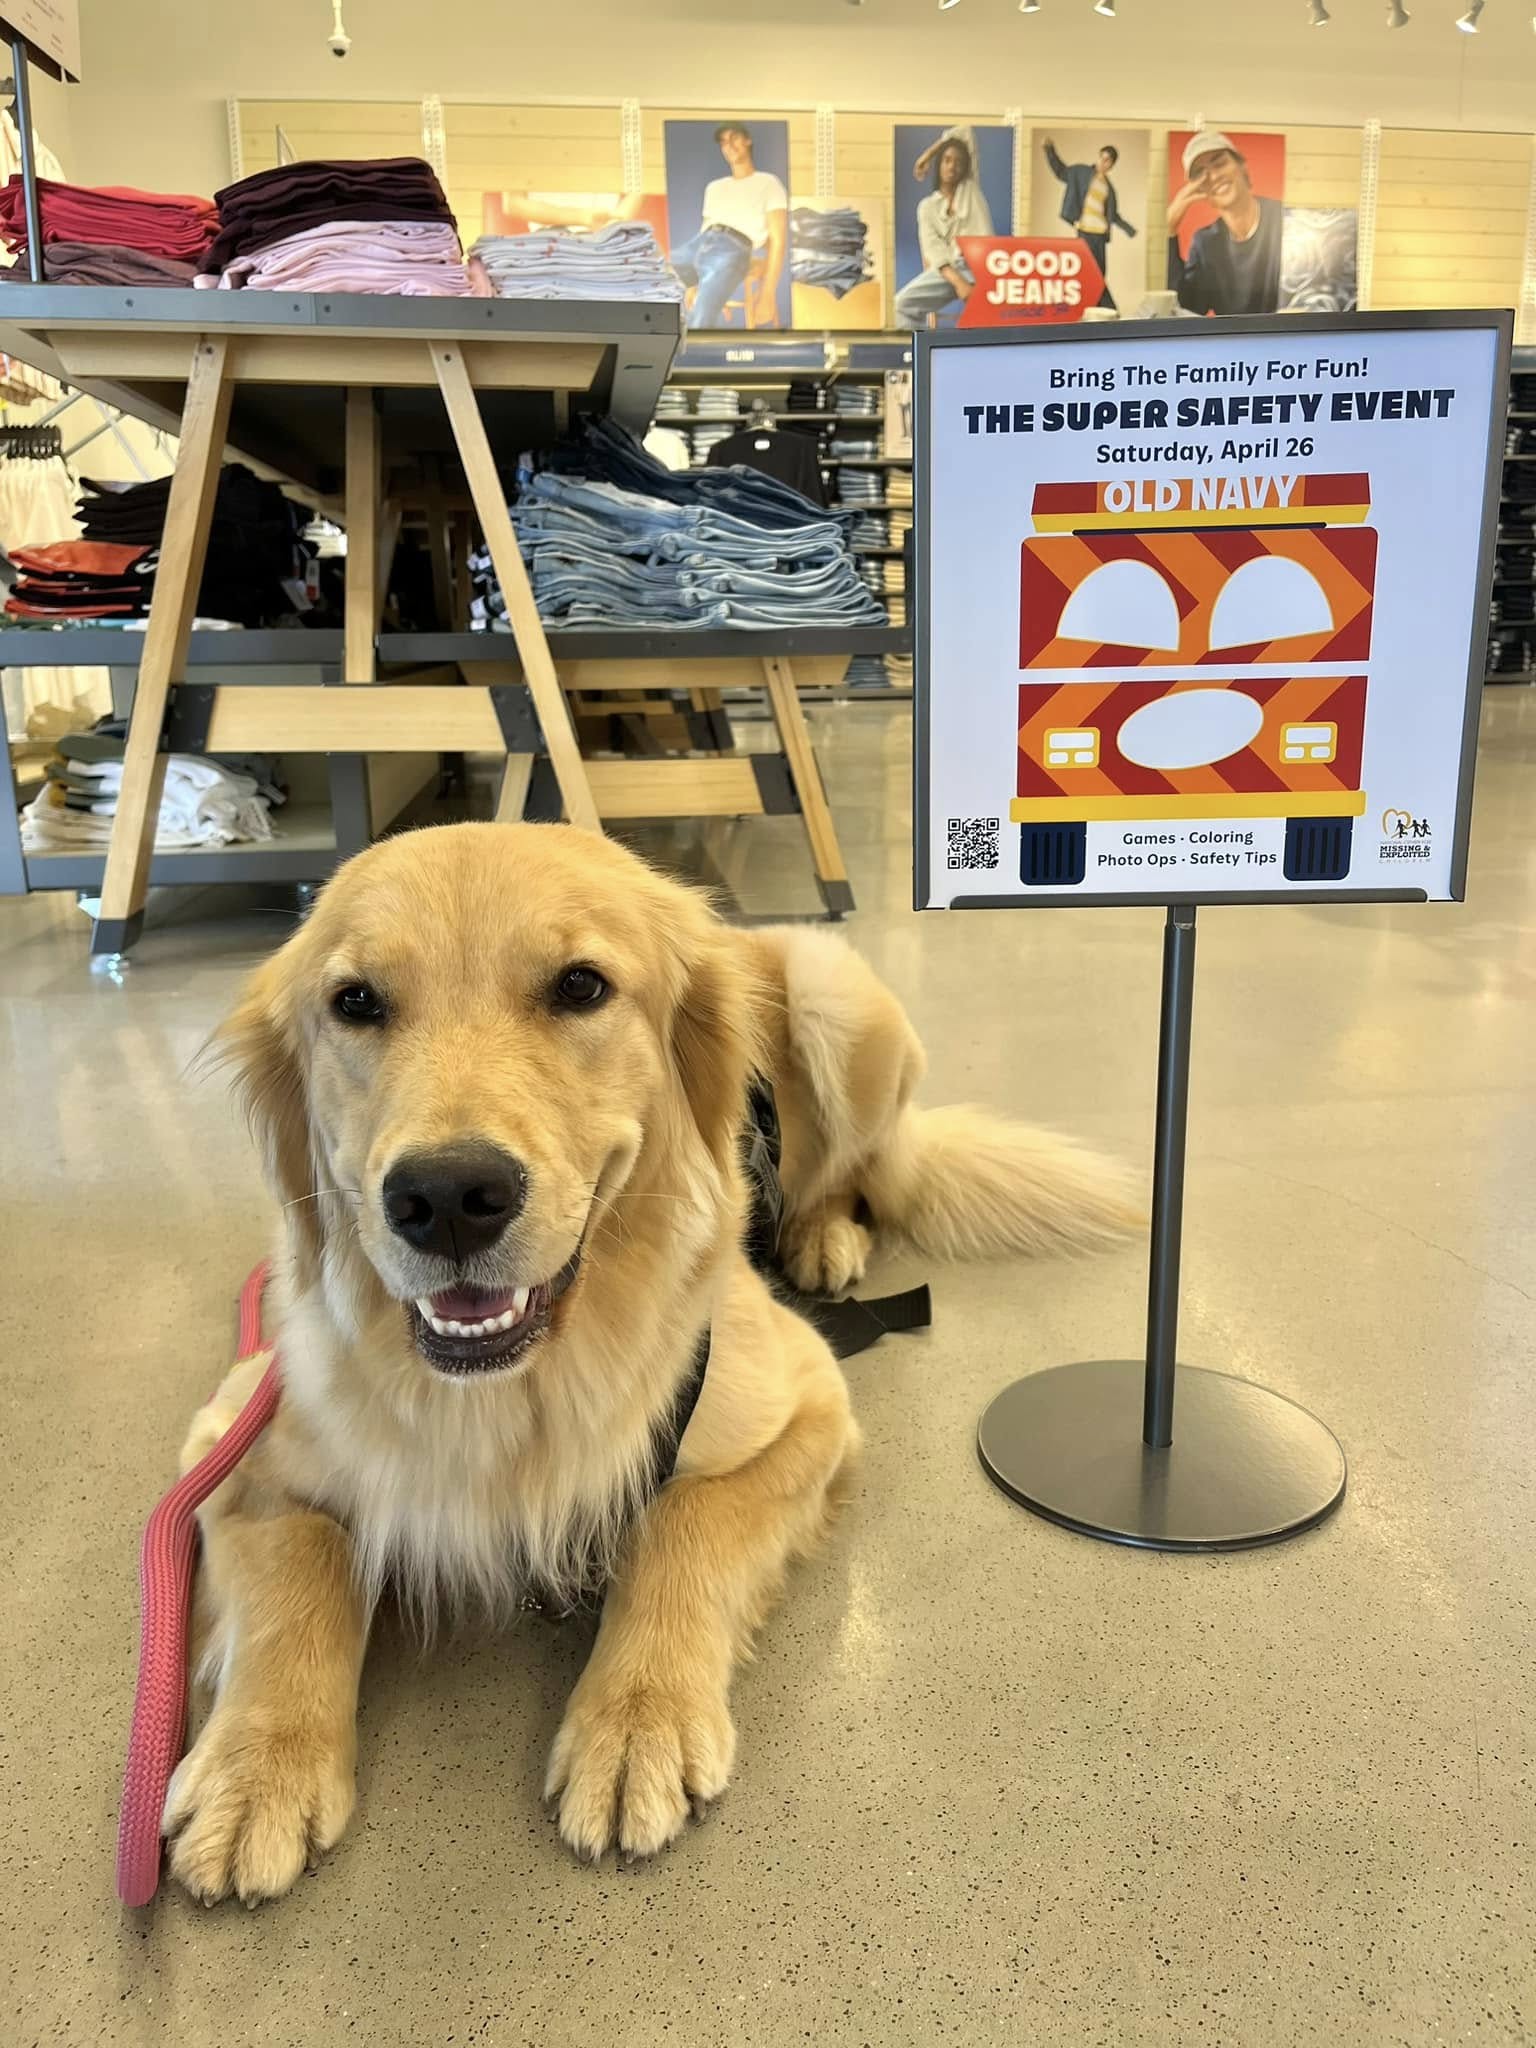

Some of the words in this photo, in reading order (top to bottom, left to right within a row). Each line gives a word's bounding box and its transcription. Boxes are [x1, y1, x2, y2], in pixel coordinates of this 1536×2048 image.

[986, 249, 1082, 277] GOOD
[986, 278, 1082, 306] JEANS
[1050, 367, 1116, 391] Bring
[1122, 365, 1168, 386] The
[1175, 361, 1259, 386] Family
[1266, 360, 1308, 381] For
[1315, 357, 1370, 378] Fun!
[963, 404, 1035, 435] THE
[1042, 398, 1169, 432] SUPER
[1176, 394, 1324, 428] SAFETY
[1330, 389, 1456, 422] EVENT
[1096, 441, 1214, 465] Saturday,
[1220, 437, 1279, 464] April
[1285, 436, 1314, 458] 26
[1103, 480, 1182, 513] OLD
[1191, 473, 1299, 511] NAVY
[1122, 832, 1176, 845] Games
[1189, 831, 1254, 846] Coloring
[1097, 854, 1143, 867] Photo
[1147, 853, 1177, 868] Ops
[1190, 851, 1241, 867] Safety
[1244, 851, 1277, 866] Tips
